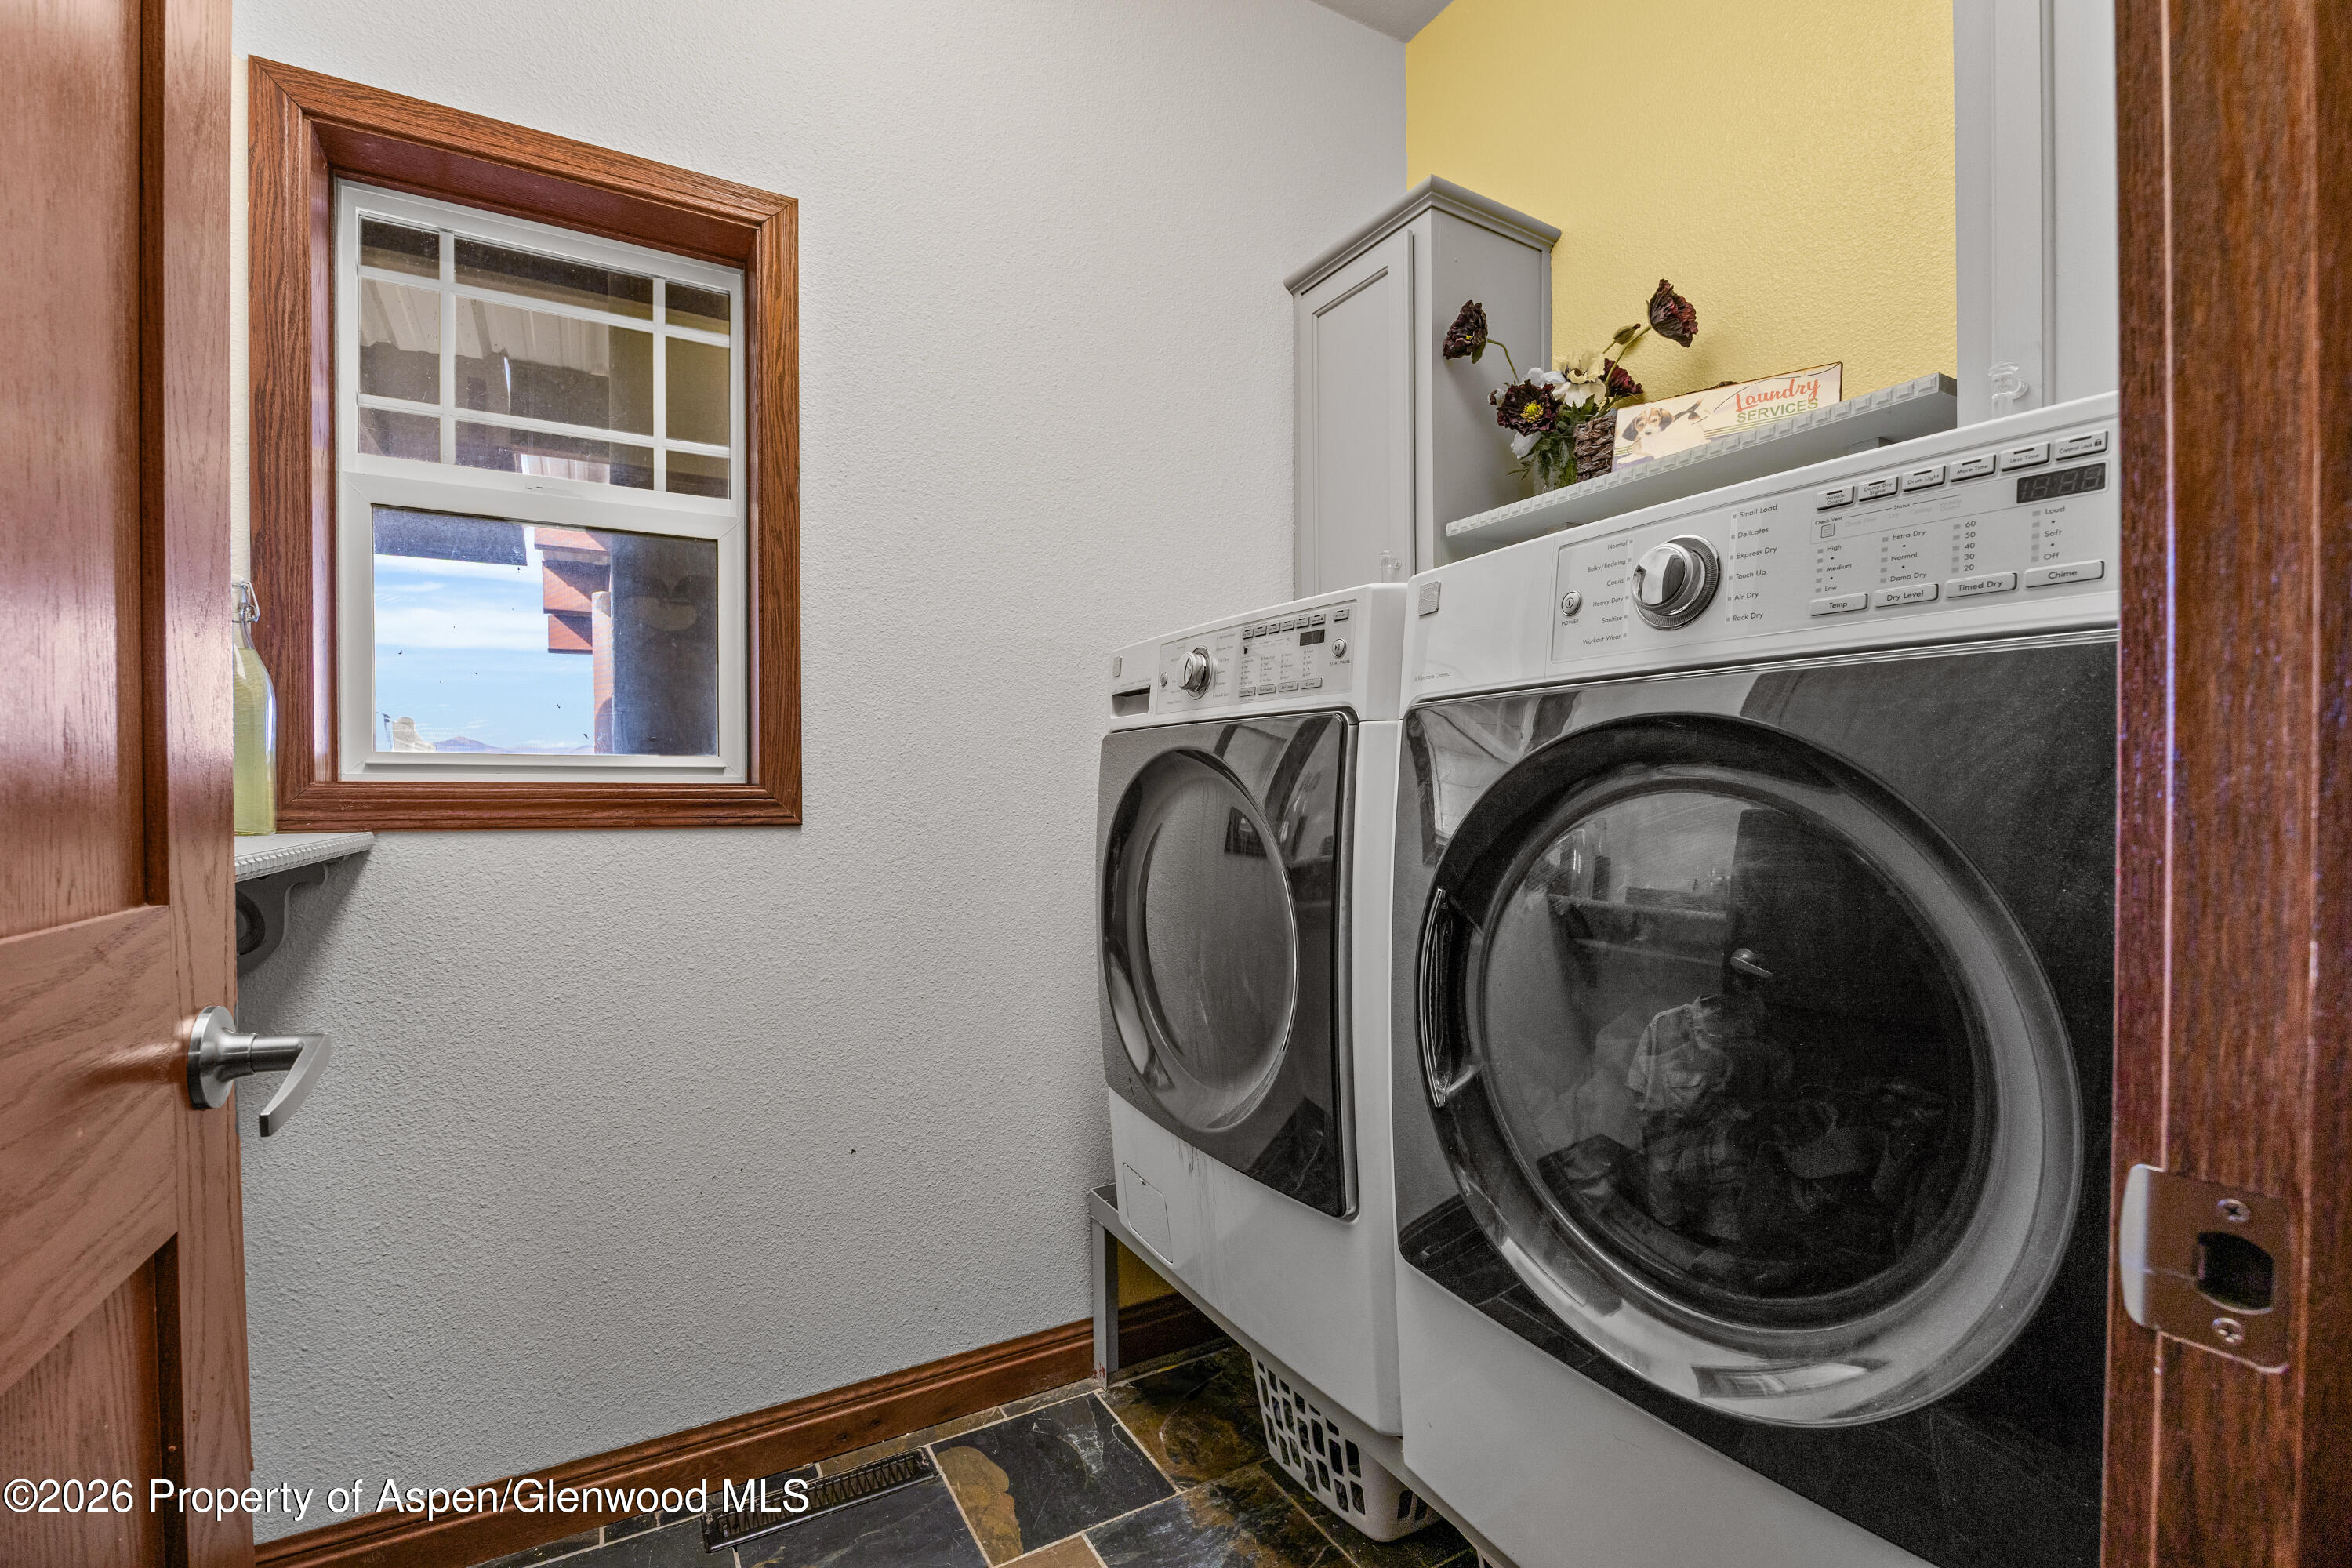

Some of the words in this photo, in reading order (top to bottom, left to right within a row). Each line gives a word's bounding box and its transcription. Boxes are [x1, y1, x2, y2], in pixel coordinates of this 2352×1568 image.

[1735, 378, 1820, 412] Laundry
[1737, 397, 1819, 423] SERVICES
[2009, 456, 2023, 464] Less
[2024, 452, 2040, 460] Time
[1956, 466, 1973, 475] More
[1925, 474, 1940, 482] Light
[1739, 508, 1758, 518] Small
[1759, 503, 1777, 514] Load
[2045, 506, 2066, 515] Loud
[1737, 527, 1769, 539] Delicates
[1913, 530, 1926, 539] Dry
[2044, 529, 2062, 538] Soft
[1607, 540, 1628, 550] Normal
[1736, 550, 1762, 560] Express
[1764, 546, 1777, 555] Dry
[1891, 552, 1918, 561] Normal
[1588, 559, 1626, 572] Bulky/Bedding
[1826, 564, 1853, 572] Medium
[1735, 571, 1754, 580] Touch
[1914, 572, 1927, 580] Dry
[2048, 570, 2078, 579] Chime
[1606, 578, 1625, 586] Casual
[1958, 582, 1984, 592] Timed
[1987, 579, 2003, 588] Dry
[1903, 590, 1924, 599] Level
[1733, 613, 1748, 622] Rack
